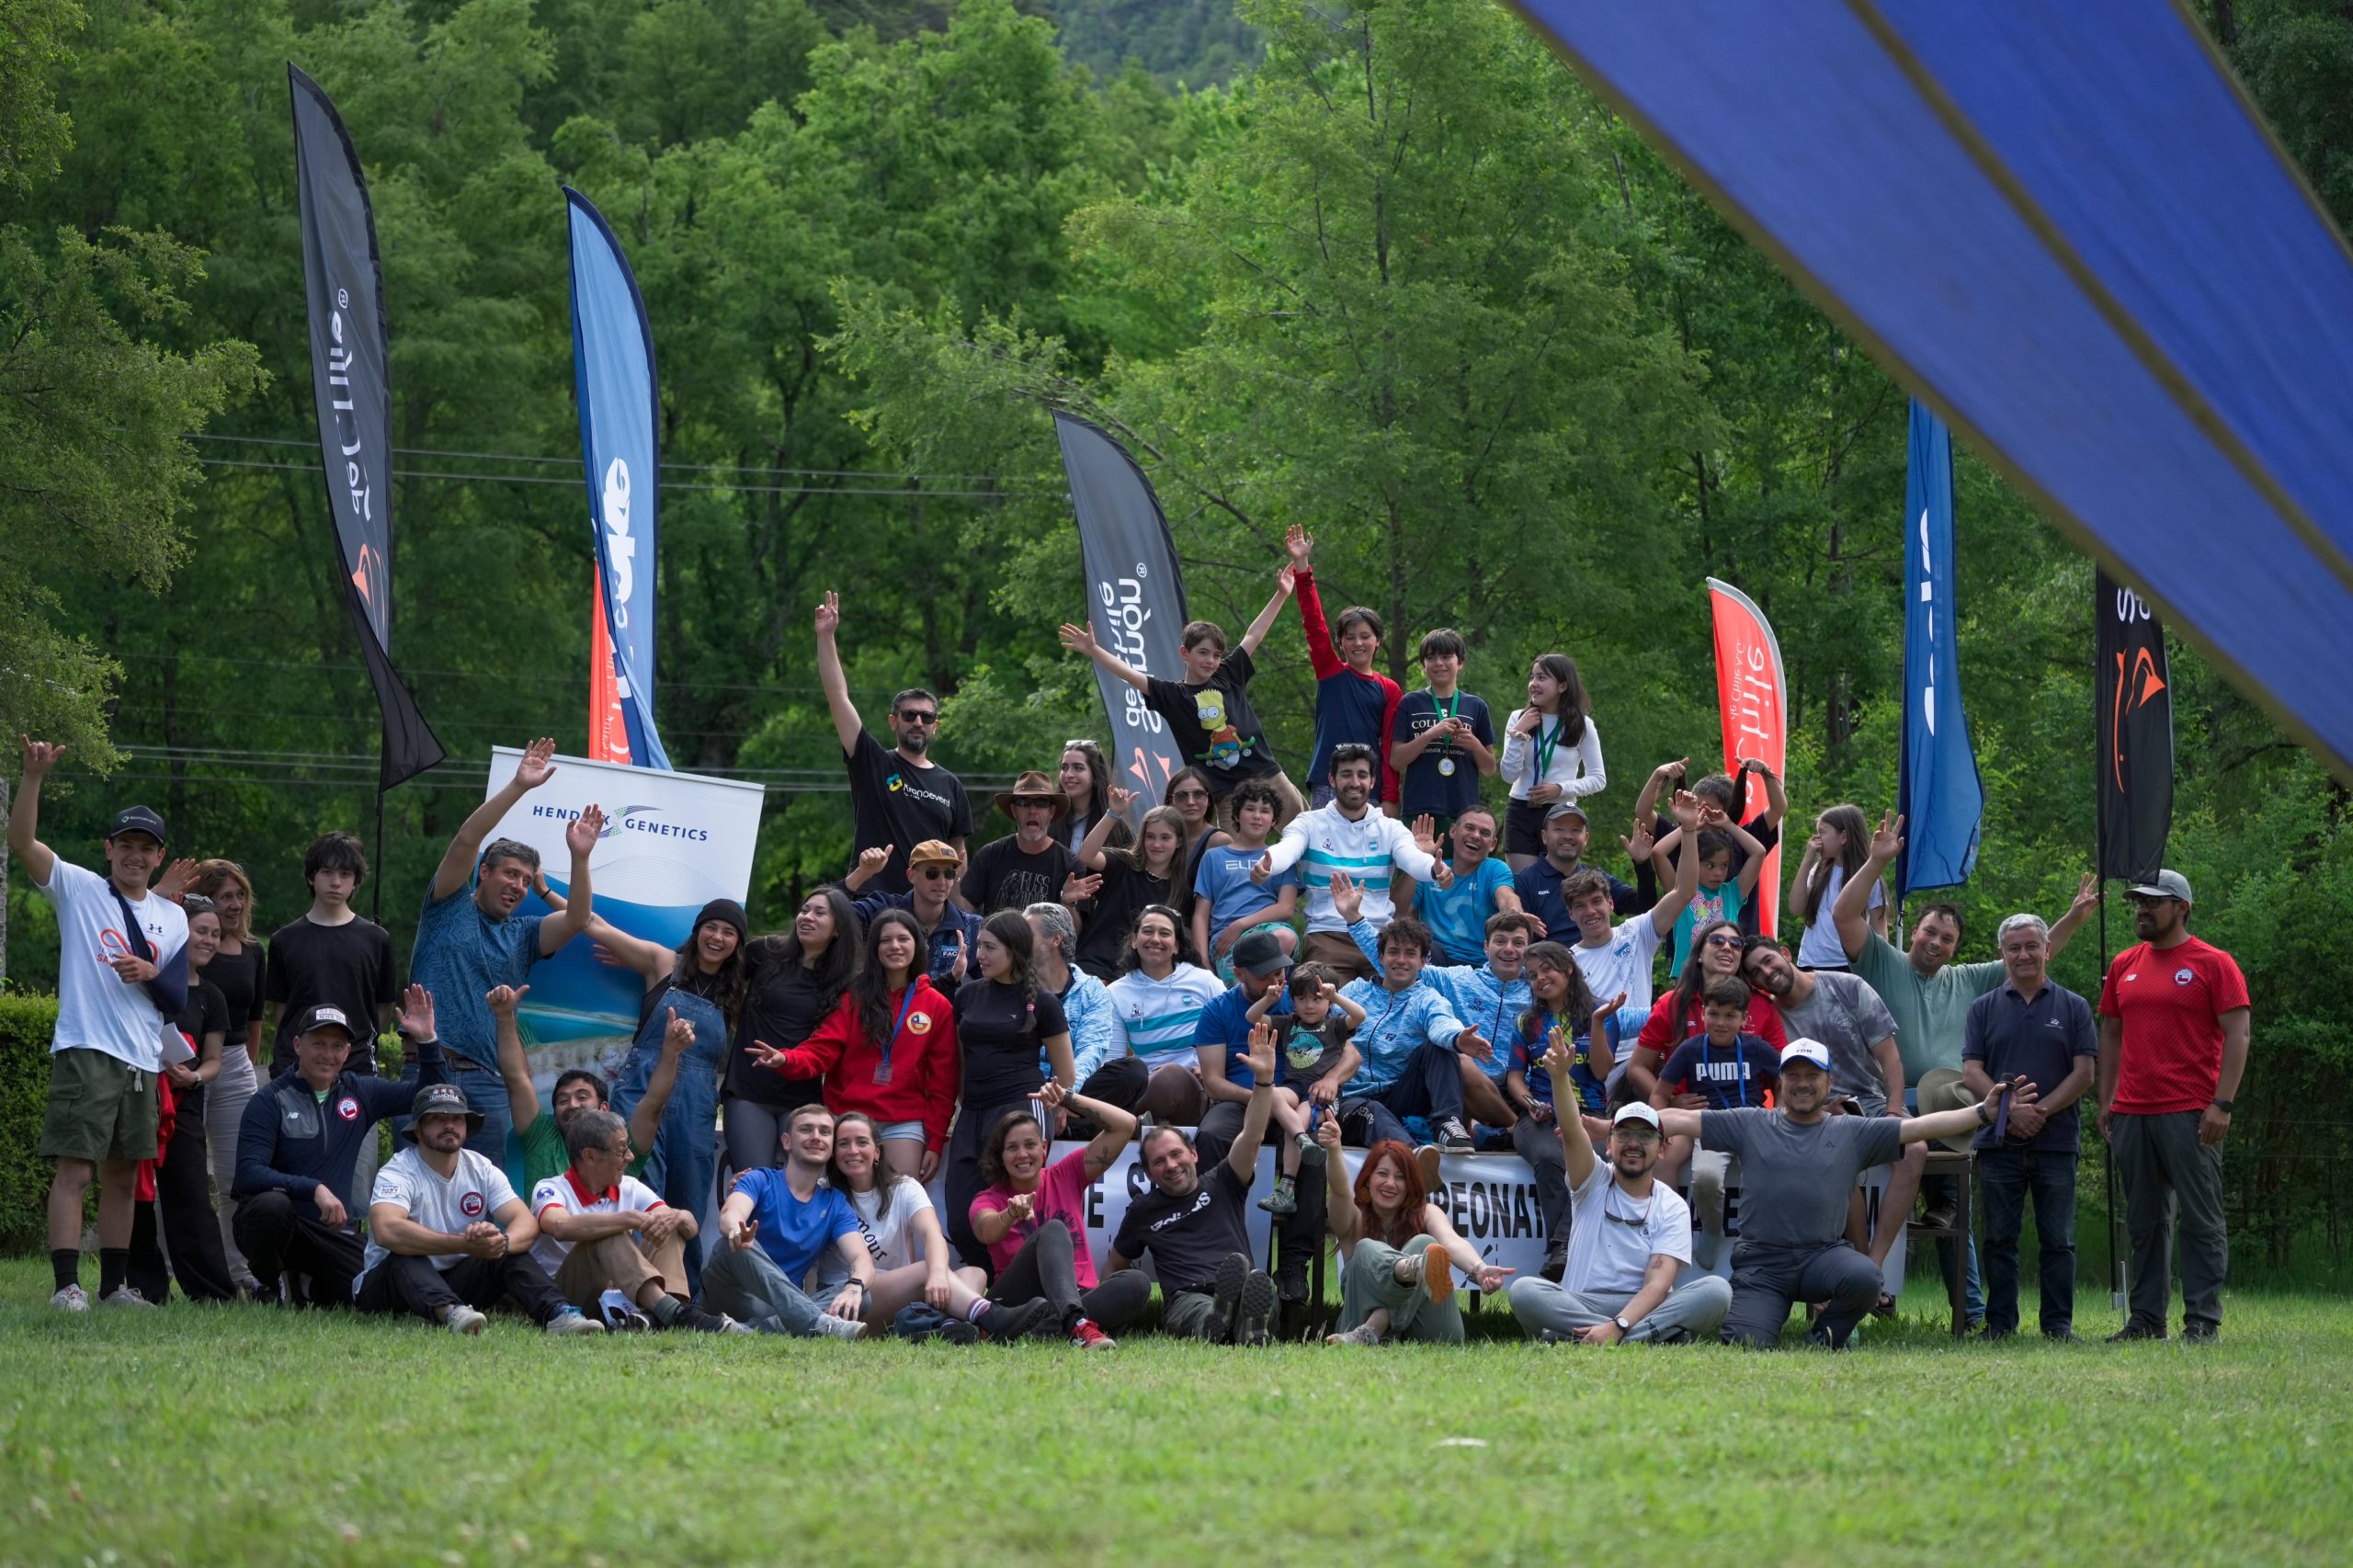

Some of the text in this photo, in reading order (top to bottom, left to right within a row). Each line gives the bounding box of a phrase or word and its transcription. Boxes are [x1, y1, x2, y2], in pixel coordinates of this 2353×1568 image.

[532, 805, 709, 842] HENDX GENETICS
[1020, 870, 1051, 896] RUSS
[1696, 1062, 1751, 1081] PUMA
[1426, 1181, 1544, 1239] PEONAT
